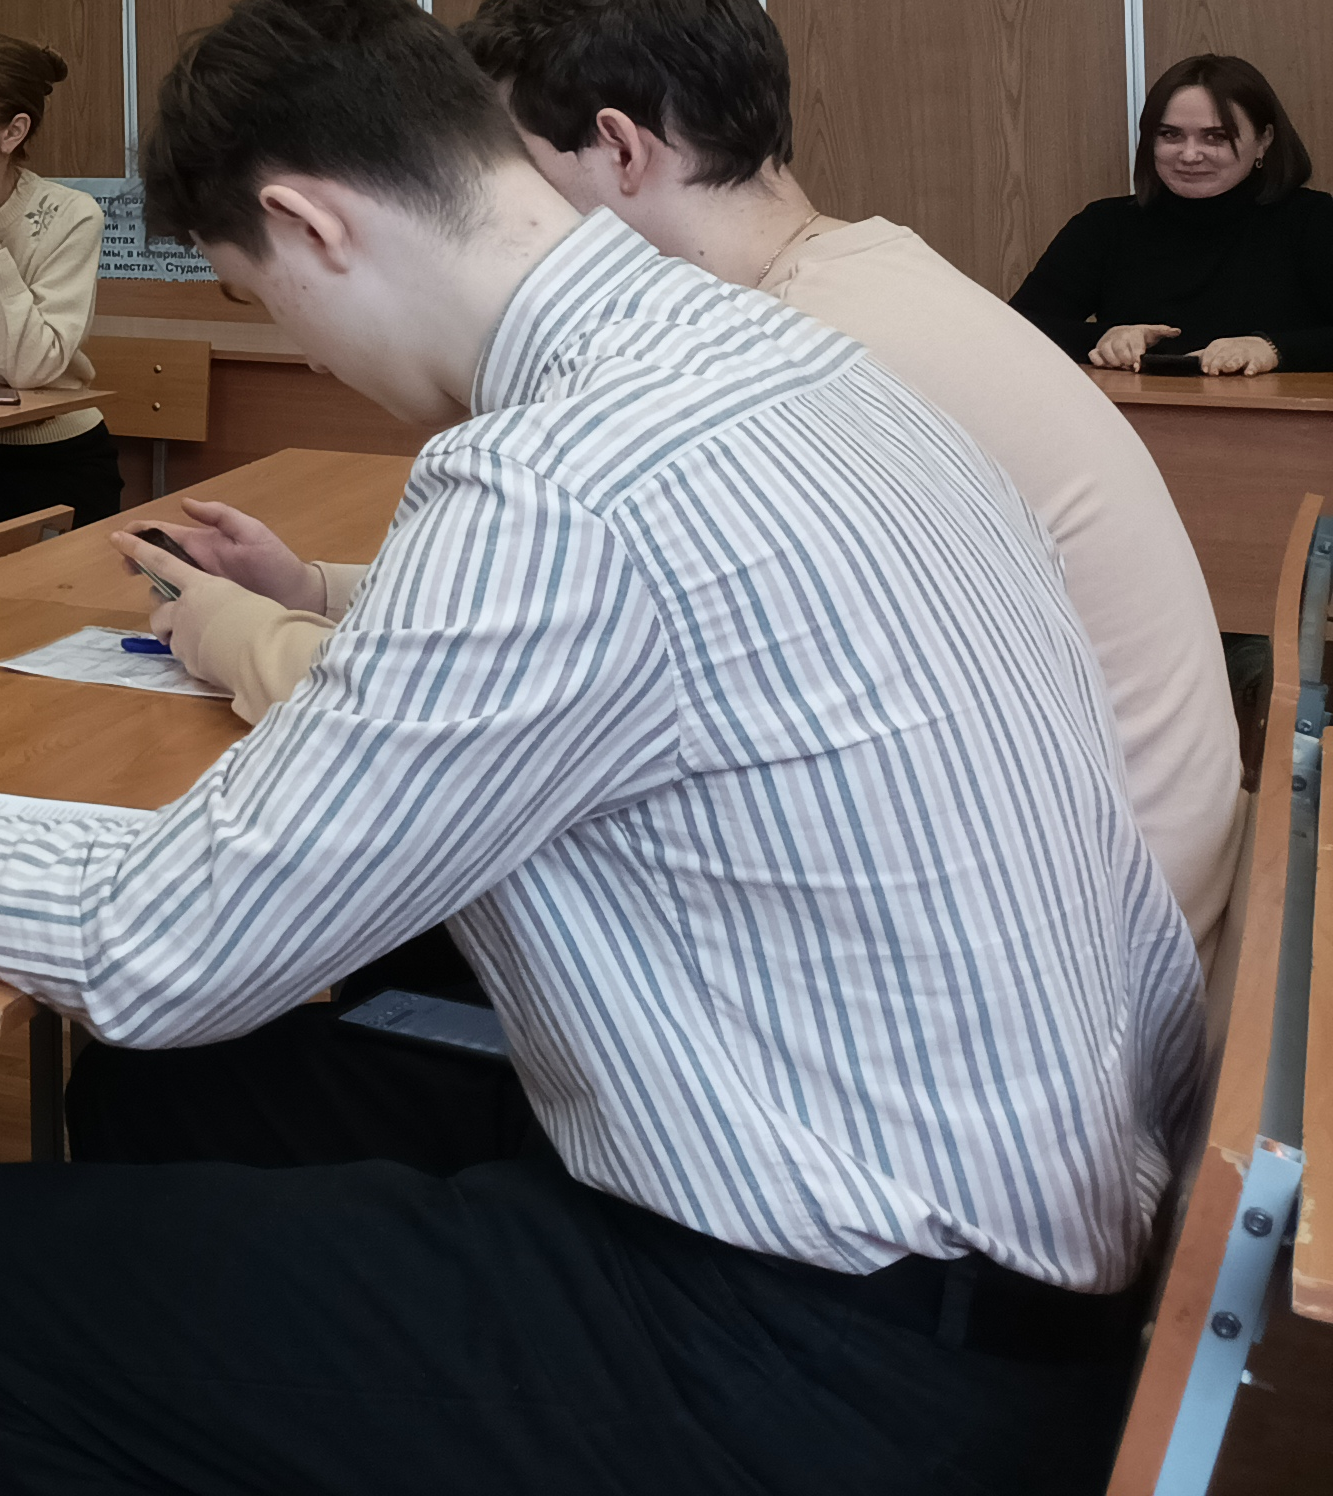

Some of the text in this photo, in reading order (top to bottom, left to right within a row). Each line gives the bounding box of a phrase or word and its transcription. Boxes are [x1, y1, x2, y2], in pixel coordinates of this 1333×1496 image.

[102, 236, 135, 245] тетах
[127, 250, 134, 258] в
[136, 250, 205, 261] нотариальн
[165, 262, 215, 275] Студент
